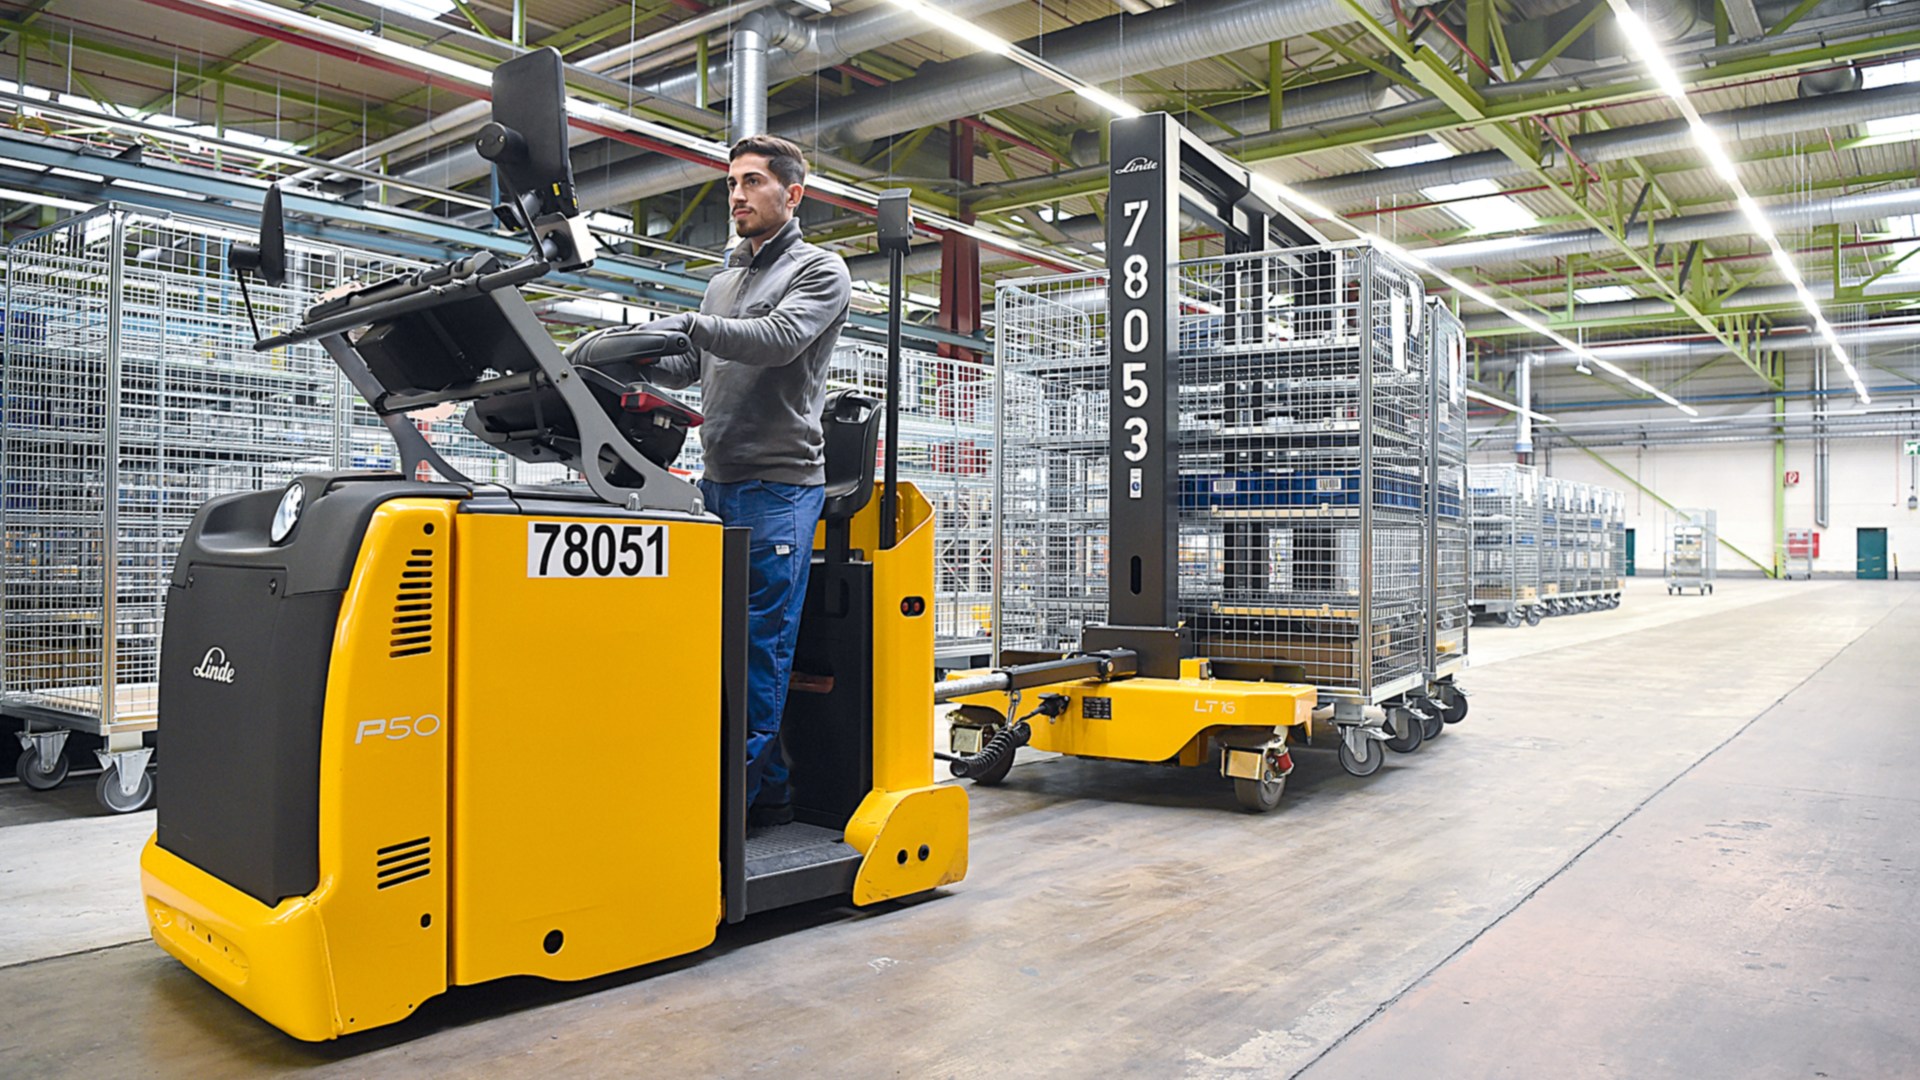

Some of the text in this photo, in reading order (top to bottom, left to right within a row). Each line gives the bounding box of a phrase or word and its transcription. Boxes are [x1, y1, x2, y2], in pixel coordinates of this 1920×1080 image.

[1115, 156, 1158, 174] Linde
[1123, 200, 1149, 462] 78053
[534, 523, 663, 577] 78051
[193, 647, 235, 683] Linde
[355, 714, 440, 744] P50
